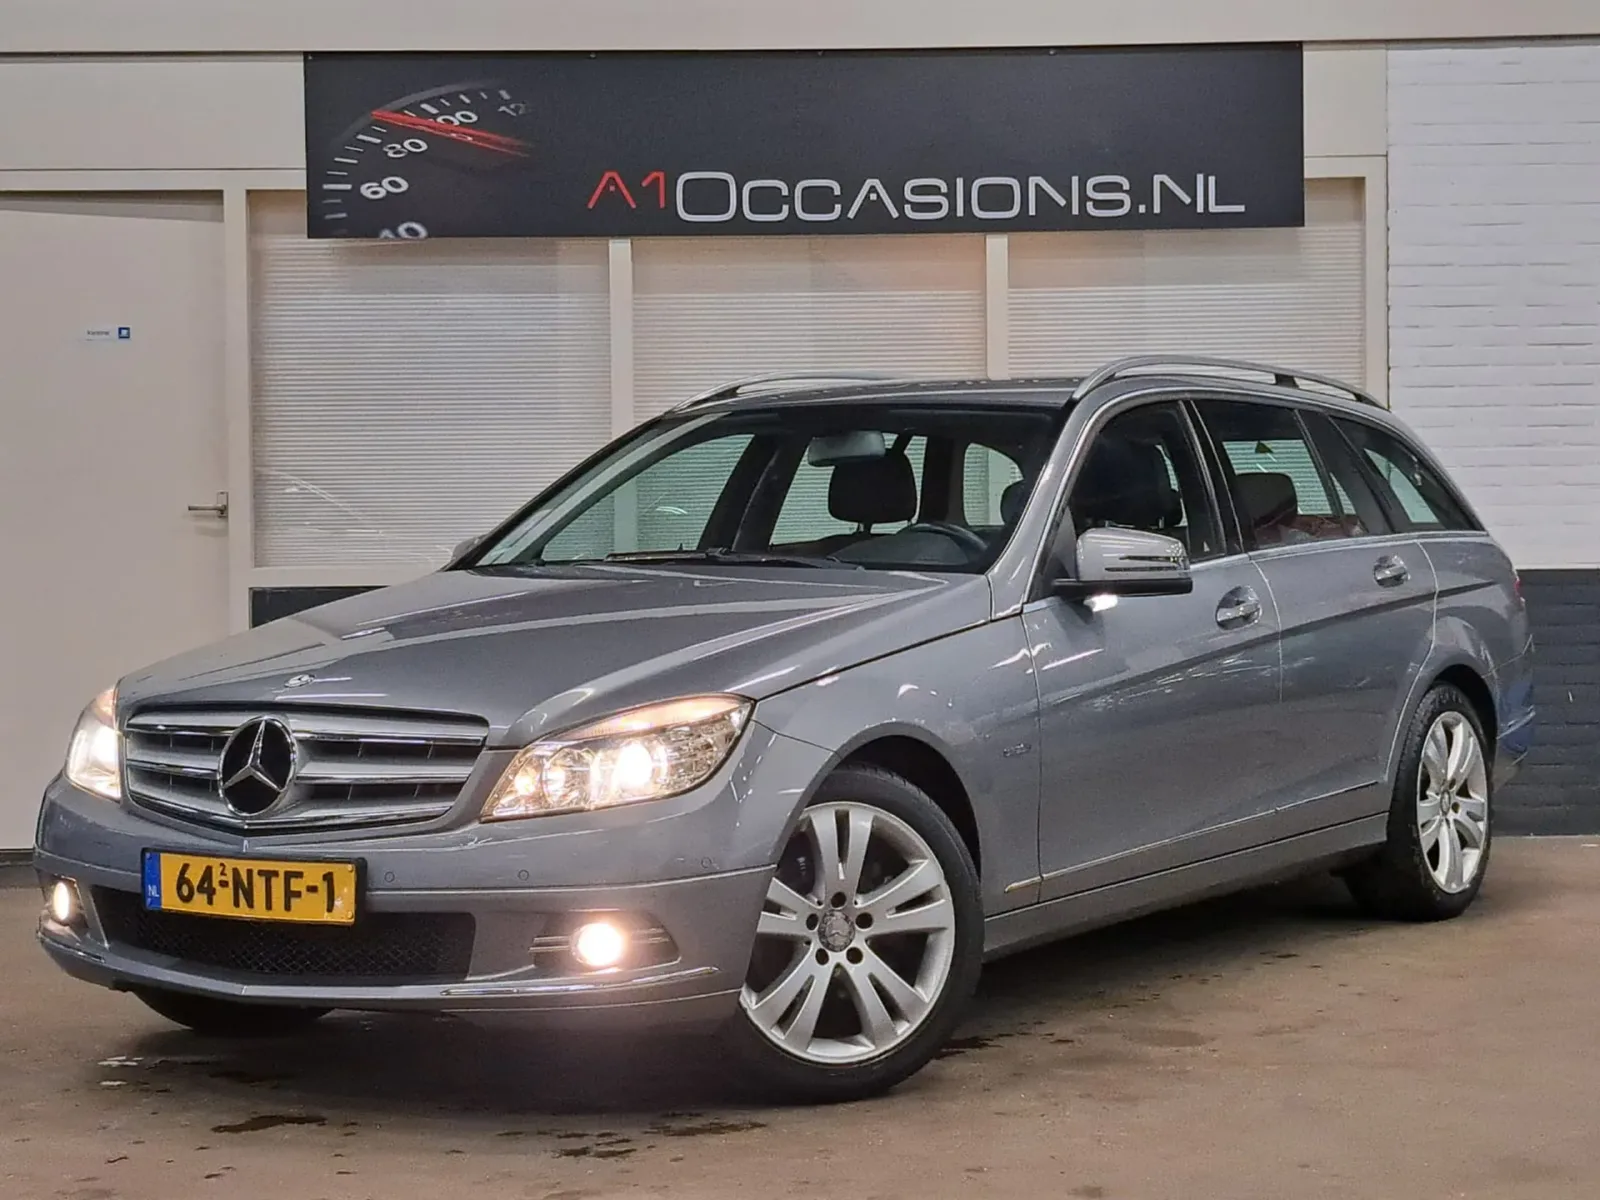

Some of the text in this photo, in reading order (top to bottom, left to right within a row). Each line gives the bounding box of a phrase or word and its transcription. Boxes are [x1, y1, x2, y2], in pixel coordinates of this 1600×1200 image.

[428, 111, 478, 126] 00
[383, 138, 428, 158] 80
[360, 176, 409, 200] 60
[587, 171, 1246, 223] A1OCCASIONS.NL
[148, 885, 160, 898] NL
[176, 862, 336, 914] 64-NTF-1
